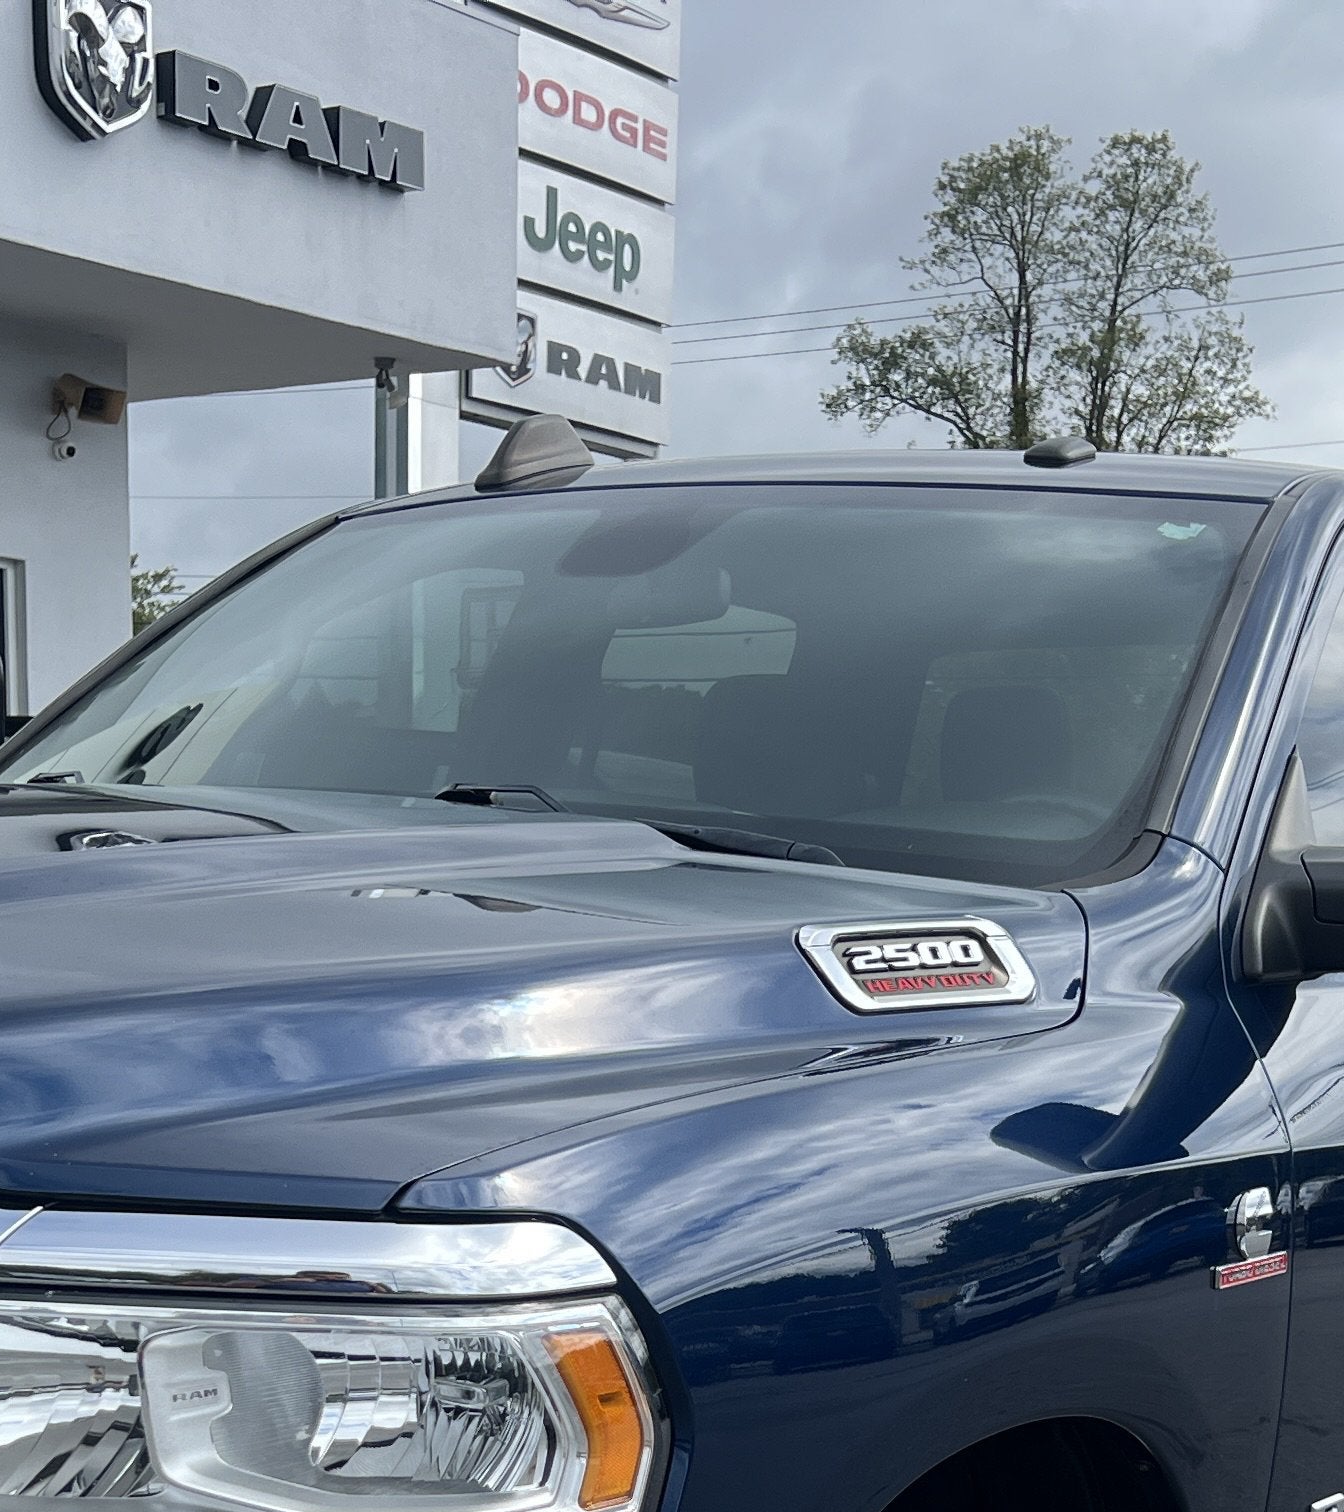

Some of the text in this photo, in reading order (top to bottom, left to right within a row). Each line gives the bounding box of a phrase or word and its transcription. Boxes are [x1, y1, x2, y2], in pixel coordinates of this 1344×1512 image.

[157, 48, 425, 193] RAM
[523, 185, 641, 292] Jeep
[546, 340, 662, 404] RAM
[844, 939, 984, 974] 2500
[863, 971, 996, 994] HEAVY DUTY
[172, 1388, 218, 1403] RAM
